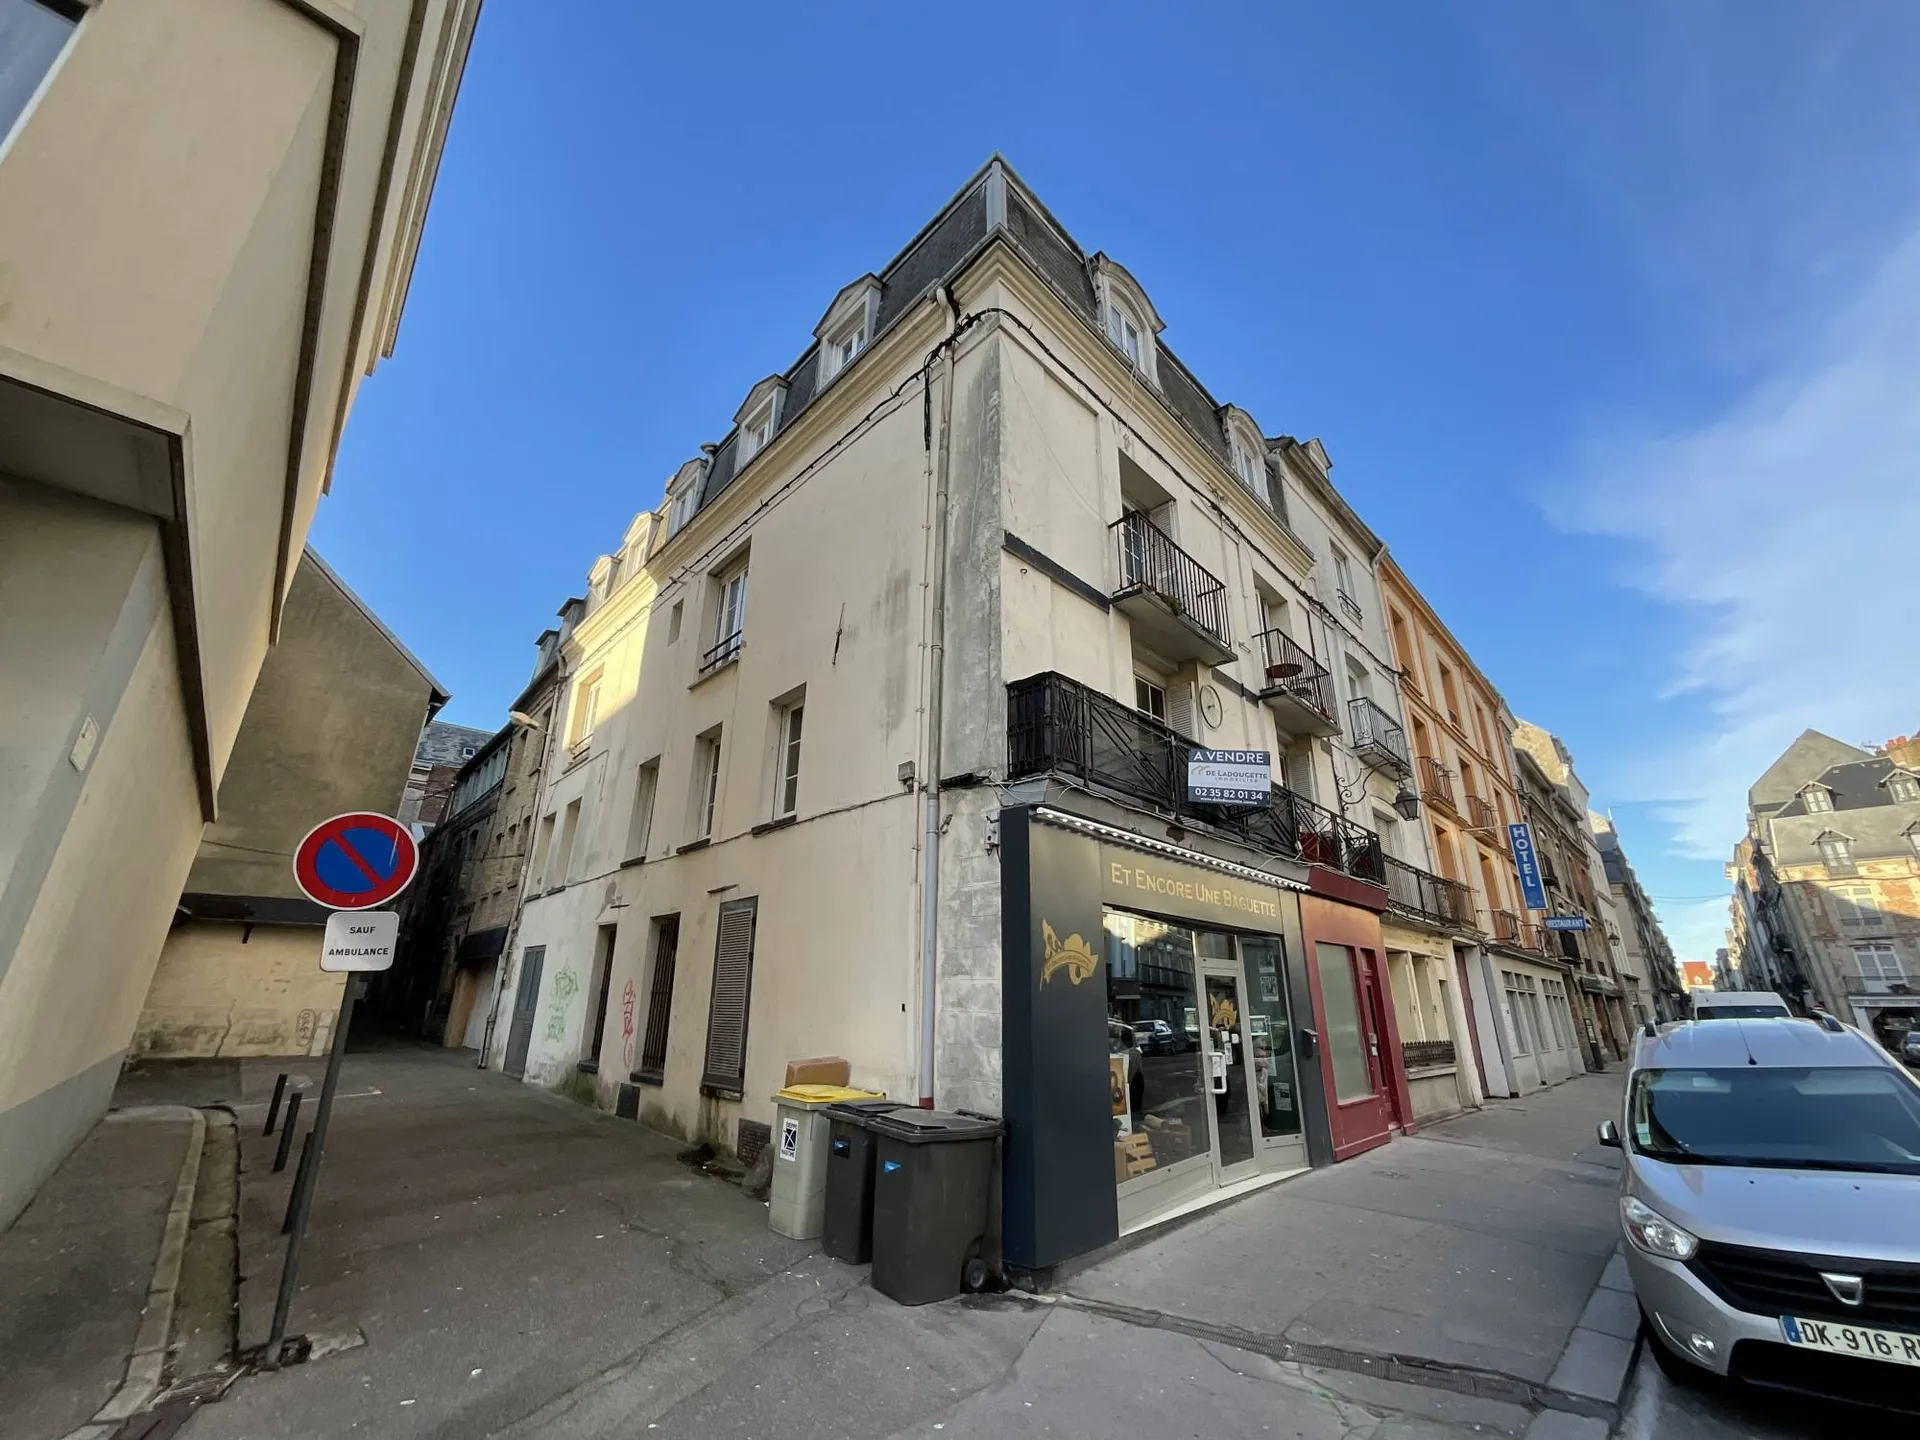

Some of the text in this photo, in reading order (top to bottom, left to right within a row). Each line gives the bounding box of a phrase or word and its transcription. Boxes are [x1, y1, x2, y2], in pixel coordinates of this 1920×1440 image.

[1193, 751, 1264, 763] A VENDRE
[1217, 769, 1268, 780] LADOUCETTE
[1195, 787, 1263, 800] 02 35 82 01 34
[1512, 827, 1535, 887] HOTEL
[349, 926, 376, 934] SAUF
[329, 947, 389, 956] AMBULANCE
[1800, 1321, 1920, 1361] DK-916-R
